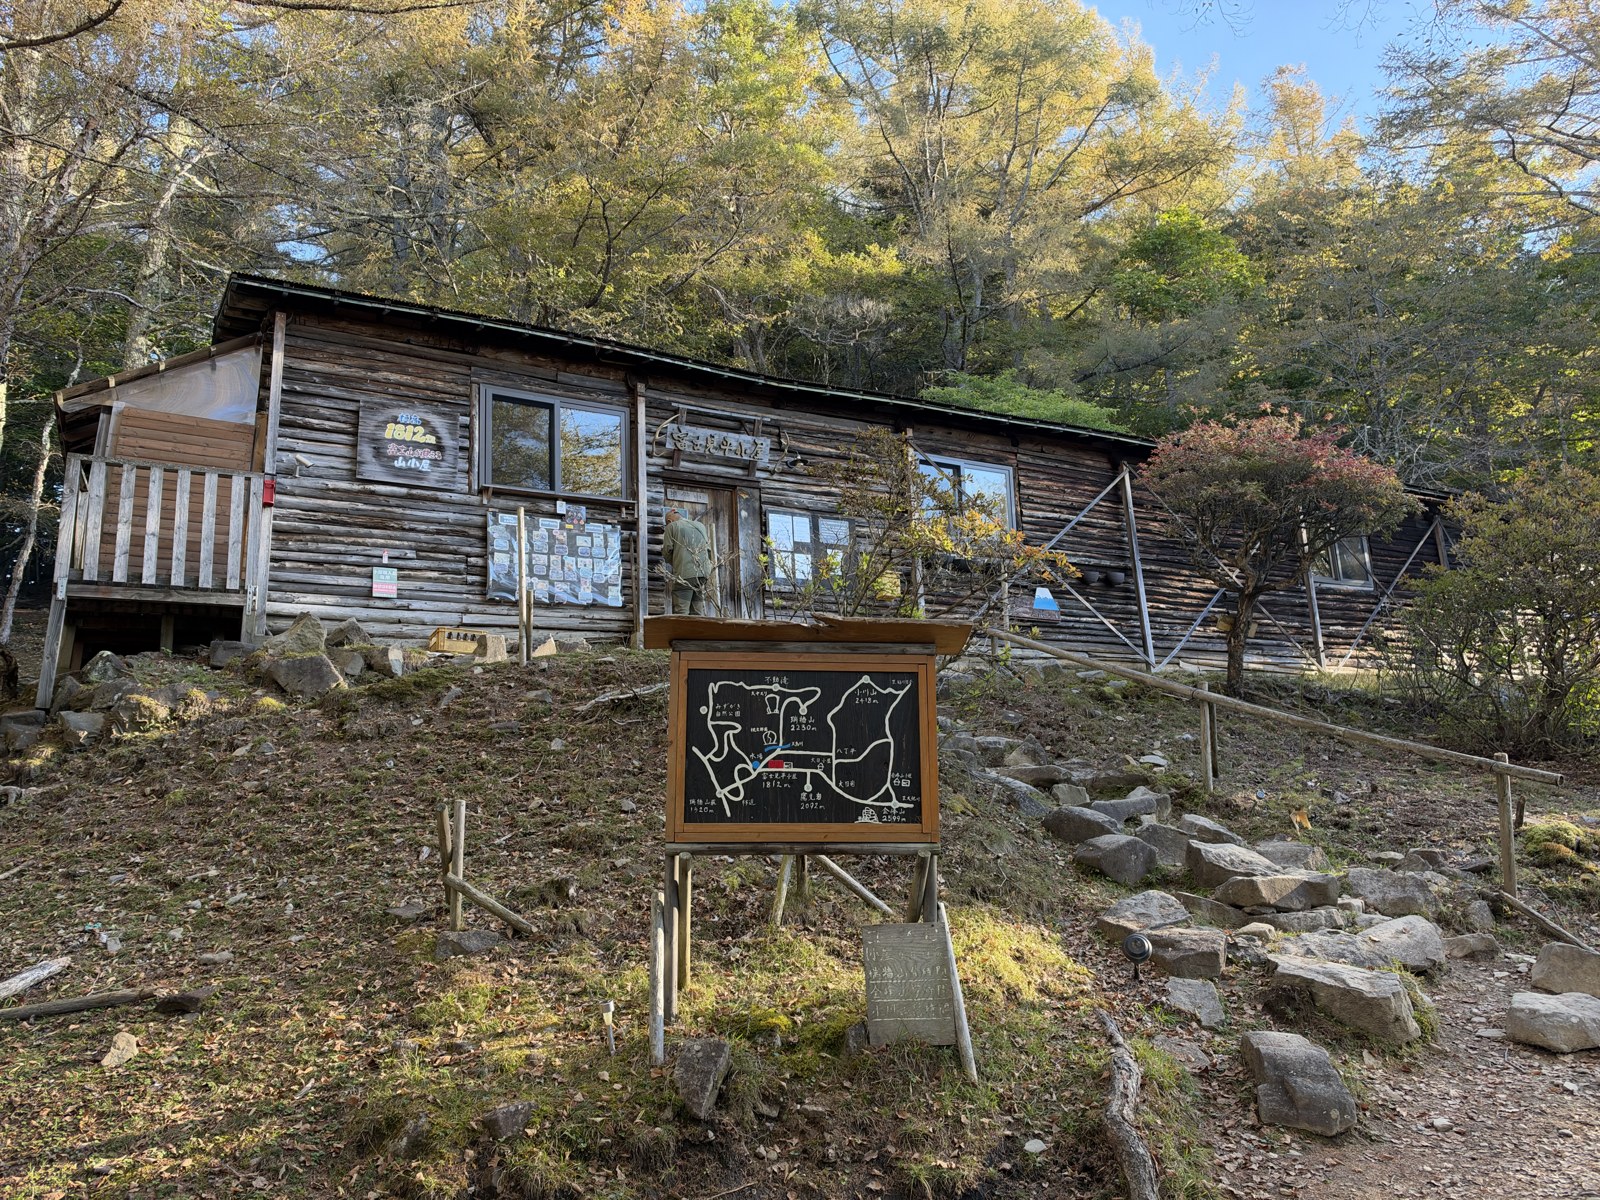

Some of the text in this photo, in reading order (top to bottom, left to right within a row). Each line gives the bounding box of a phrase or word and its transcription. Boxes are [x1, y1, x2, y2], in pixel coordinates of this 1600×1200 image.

[384, 423, 436, 444] 1812m
[670, 426, 764, 460] 富士見平小屋
[394, 456, 432, 472] 山小屋
[764, 676, 789, 685] 不動滝
[854, 688, 878, 696] 小川山
[761, 772, 798, 780] 富士見平小屋
